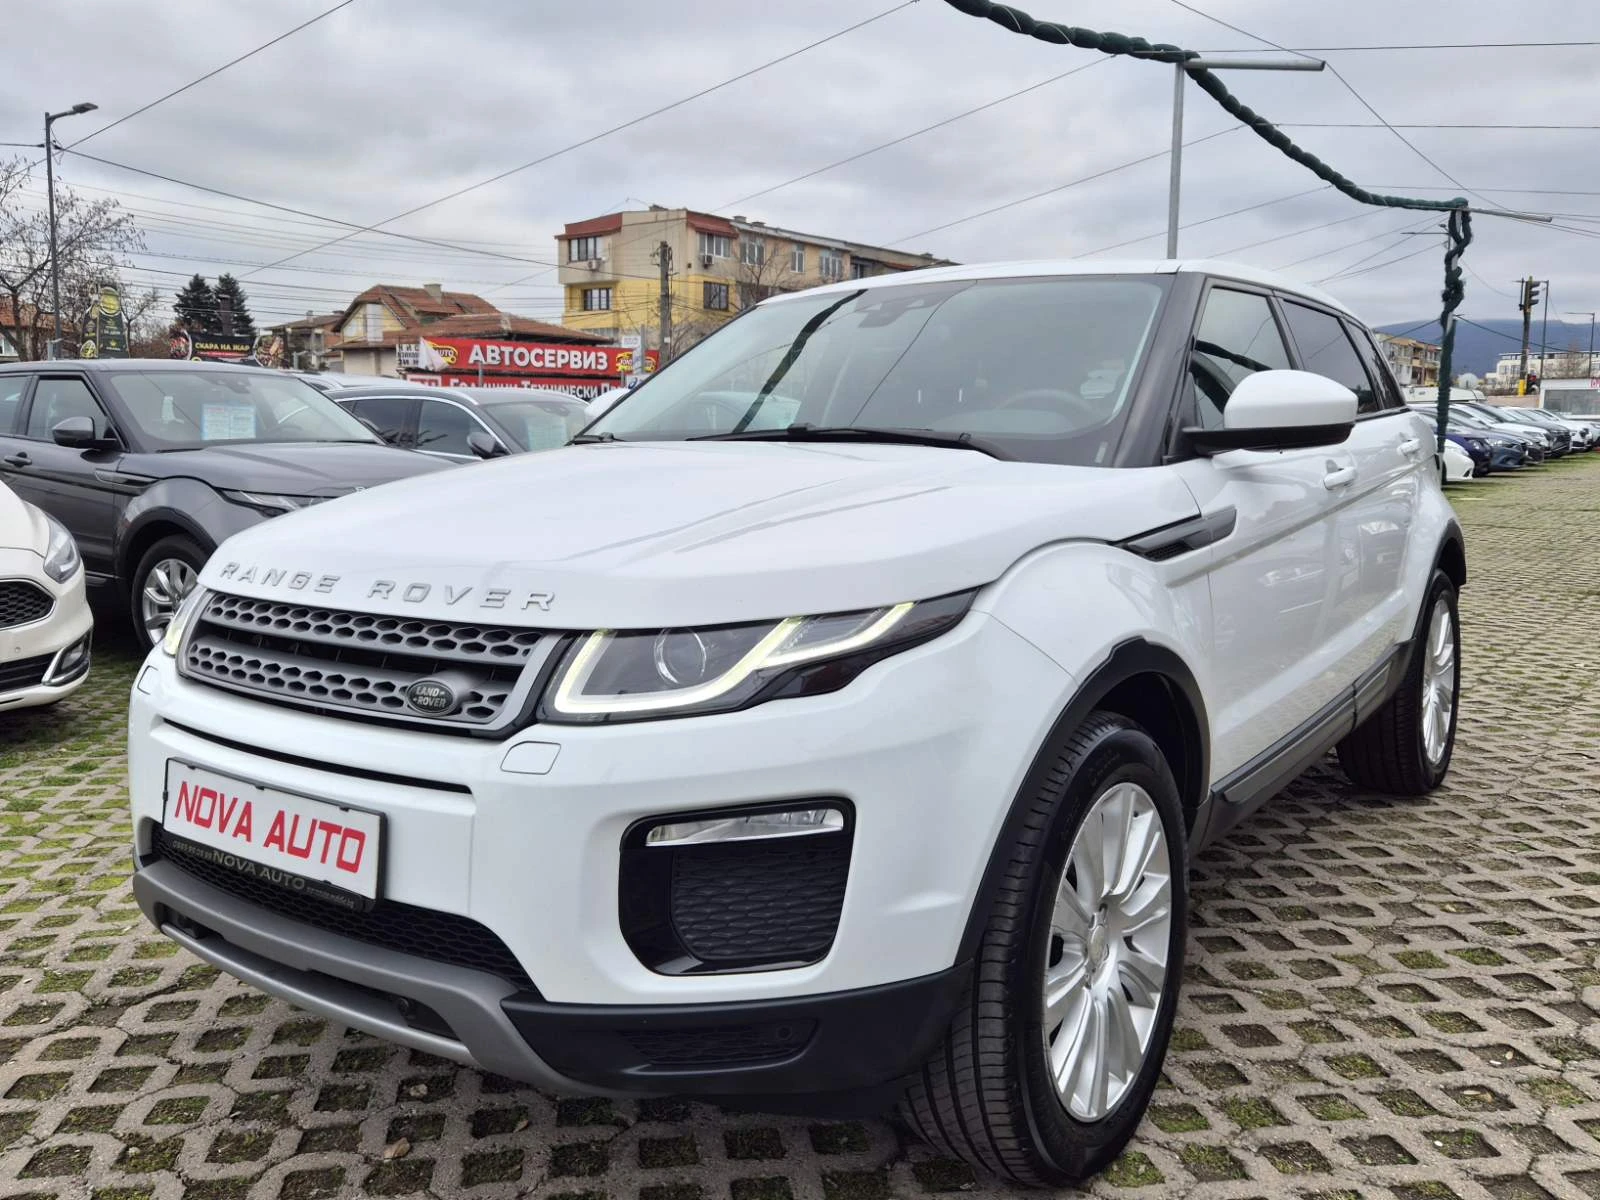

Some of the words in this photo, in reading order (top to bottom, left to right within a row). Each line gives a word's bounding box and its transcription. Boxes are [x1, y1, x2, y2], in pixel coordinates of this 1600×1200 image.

[195, 342, 219, 350] СКАРА
[232, 343, 250, 351] ЖАР
[468, 344, 608, 370] АВТОСЕРВИЗ
[219, 561, 341, 593] RANGE
[367, 579, 556, 612] ROVER
[416, 686, 440, 697] LAND
[417, 696, 446, 708] ROVER
[175, 780, 252, 843] NOVA
[263, 809, 367, 874] AUTO
[212, 850, 257, 875] NOVA
[259, 866, 306, 891] AUTO
